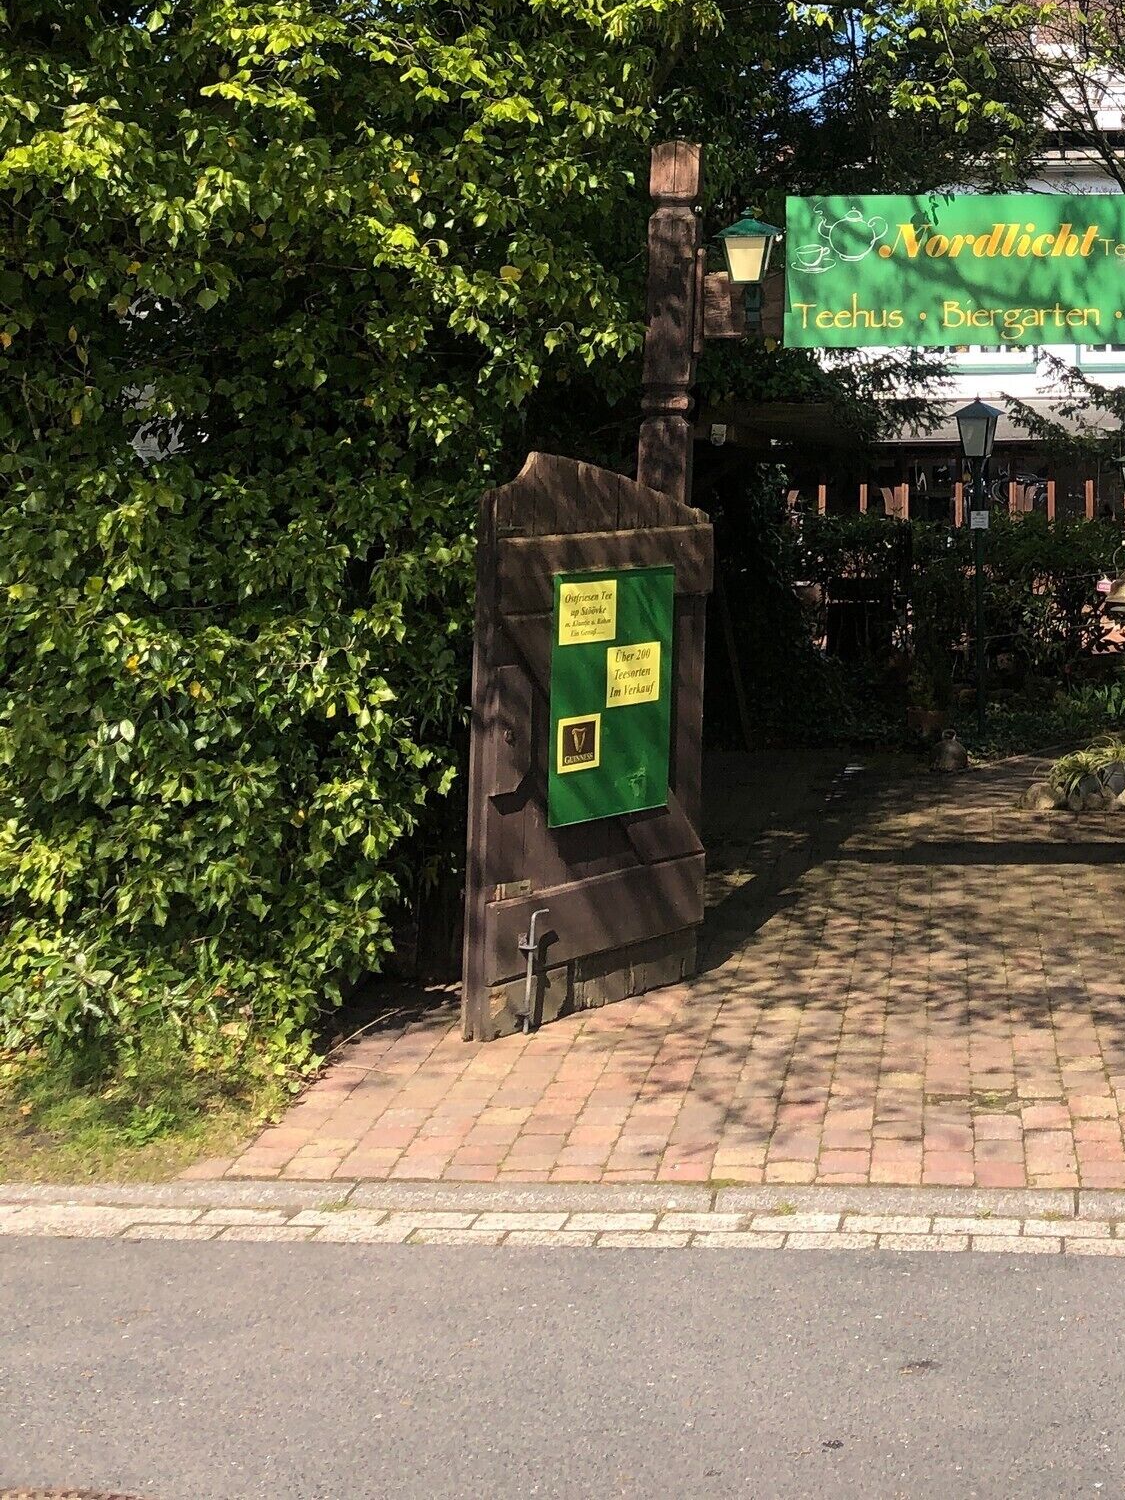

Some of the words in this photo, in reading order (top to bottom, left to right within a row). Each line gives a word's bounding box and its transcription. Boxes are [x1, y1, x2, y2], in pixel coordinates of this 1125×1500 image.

[879, 223, 1099, 258] Nordlicht
[792, 293, 904, 329] Teehus
[943, 299, 1100, 340] Biergarten
[601, 591, 612, 601] Tee
[616, 649, 635, 663] Über
[636, 648, 651, 660] 200
[615, 668, 651, 680] Teesorten
[610, 686, 621, 698] Im
[624, 681, 656, 695] Verkauf
